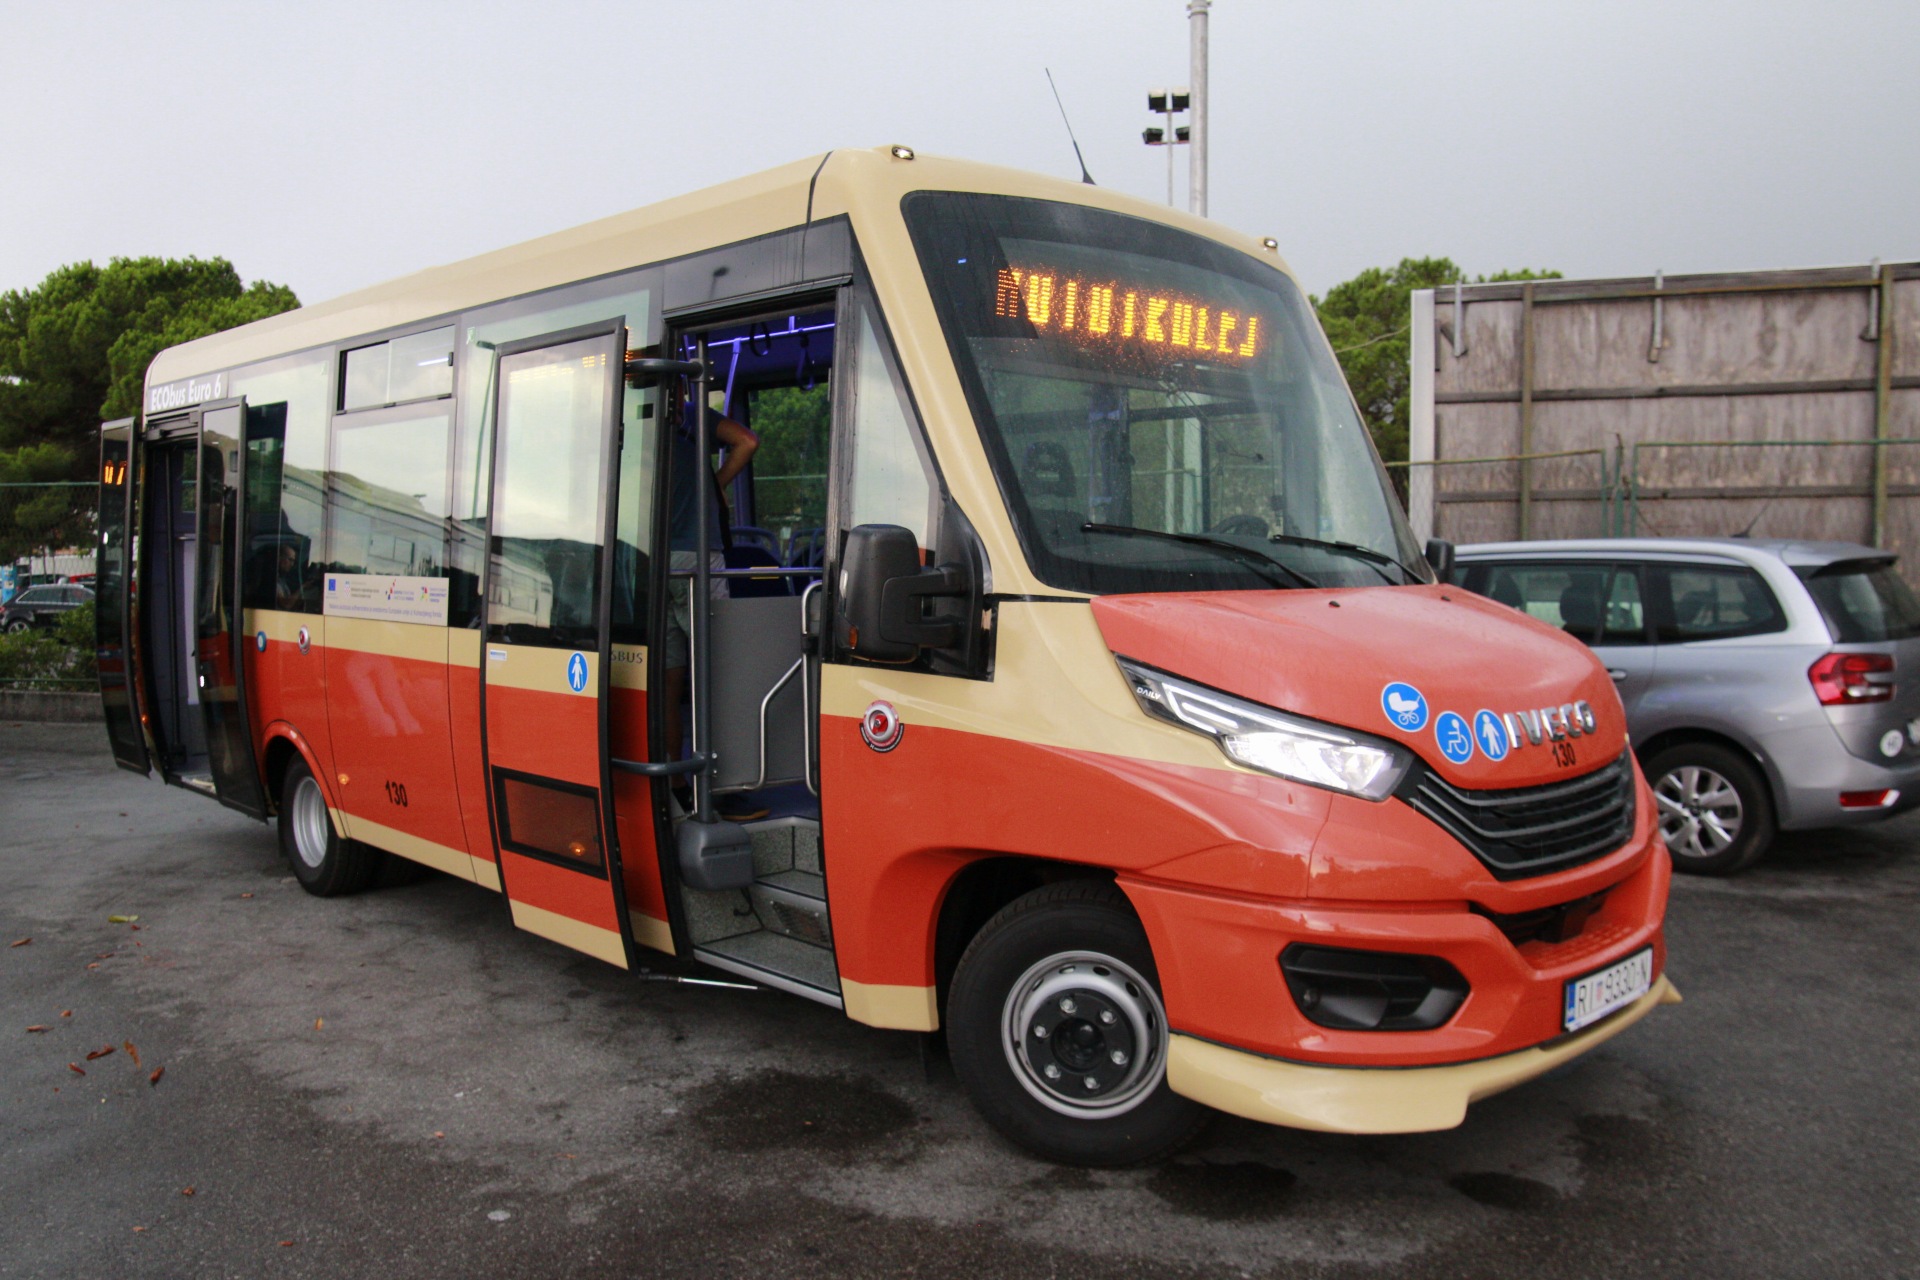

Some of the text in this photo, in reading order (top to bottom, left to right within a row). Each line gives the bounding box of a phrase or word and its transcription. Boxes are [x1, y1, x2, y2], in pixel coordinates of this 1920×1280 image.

[150, 373, 222, 412] ECObus Euro 6
[1136, 685, 1162, 700] DAILY
[1503, 700, 1597, 749] IVECO
[1552, 742, 1576, 768] 130
[385, 780, 408, 807] 130
